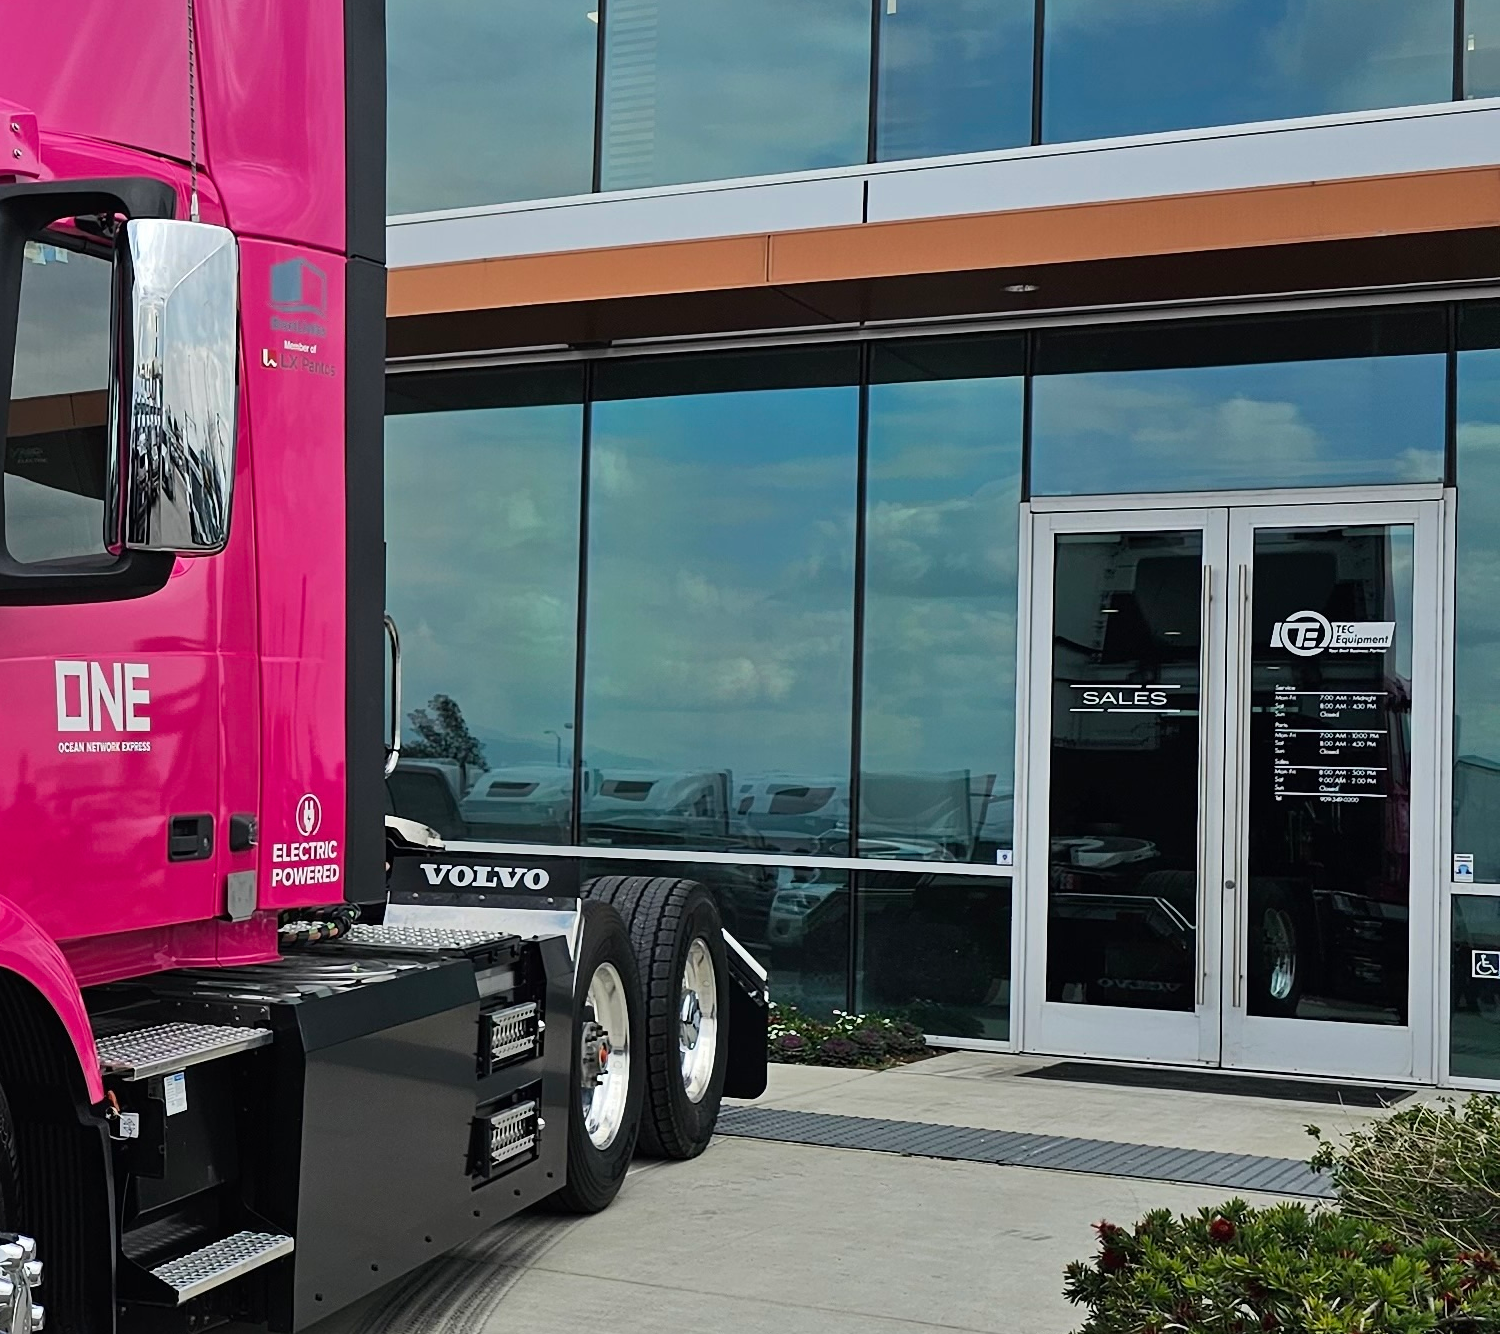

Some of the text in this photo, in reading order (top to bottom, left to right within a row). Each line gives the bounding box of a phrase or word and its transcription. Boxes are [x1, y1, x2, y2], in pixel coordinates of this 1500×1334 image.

[281, 354, 298, 369] LX
[1336, 624, 1354, 634] TEC
[1336, 635, 1388, 645] Equipment
[55, 660, 151, 731] ONE
[1083, 691, 1167, 706] SALES
[58, 742, 150, 753] OCEAN NETWORK EXPRESS
[273, 841, 338, 862] ELECTRIC
[272, 865, 340, 887] POWERED
[420, 864, 549, 890] VOLVO
